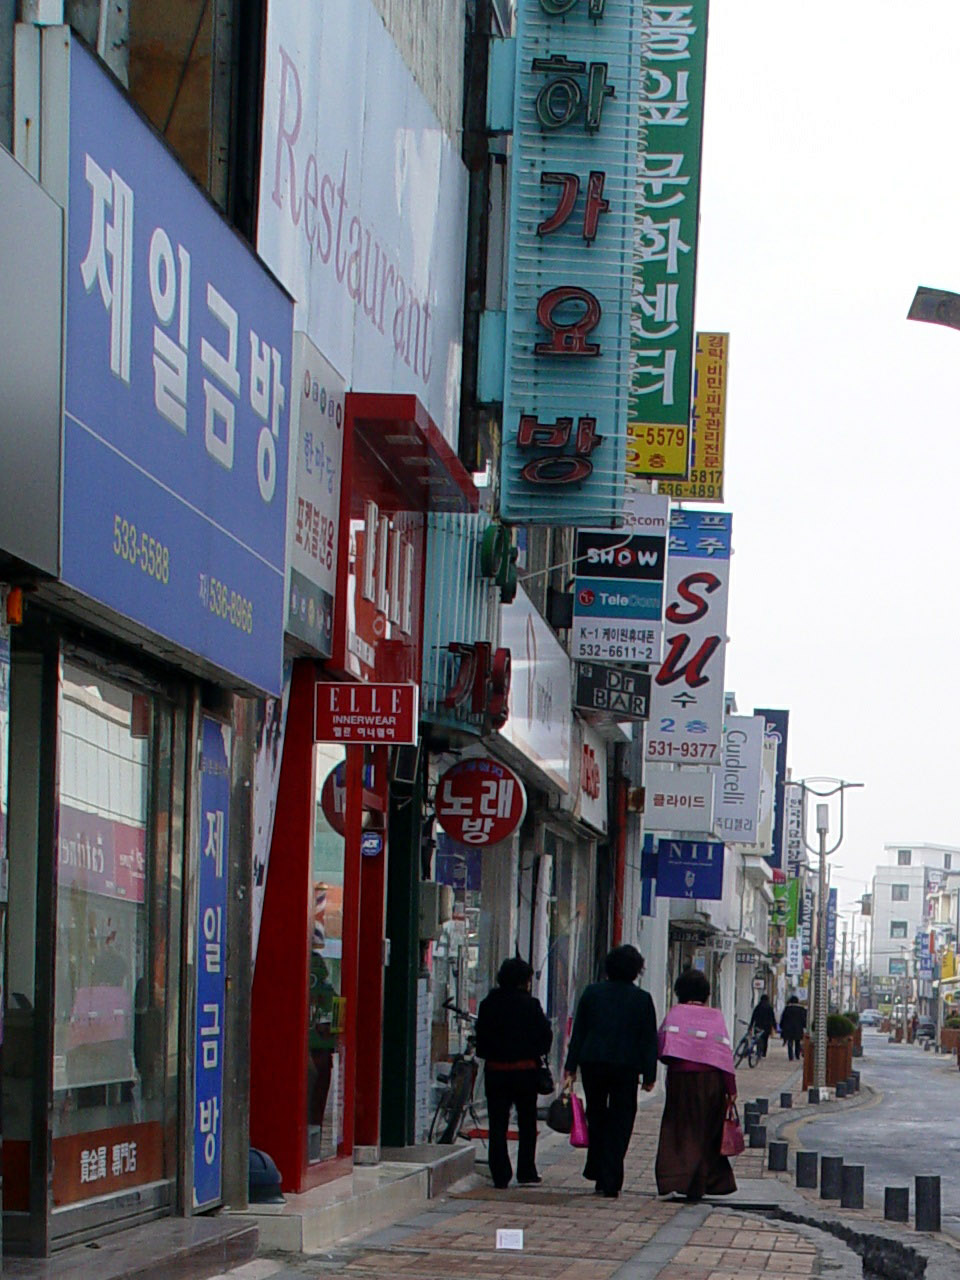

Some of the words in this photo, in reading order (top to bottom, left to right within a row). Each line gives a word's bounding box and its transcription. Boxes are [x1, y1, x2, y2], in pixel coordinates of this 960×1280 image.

[271, 46, 435, 384] Restaurant
[80, 153, 285, 501] 제일금방
[658, 484, 722, 498] 536-4891
[113, 513, 170, 585] 533-5588
[587, 549, 659, 567] SHOW
[330, 688, 402, 713] ELLE
[594, 690, 646, 714] BAR
[671, 692, 698, 708] 수
[332, 715, 397, 725] INNERWEAR
[648, 741, 718, 758] 531-9377
[723, 730, 748, 805] Guidicelli
[441, 779, 515, 819] 노래
[462, 817, 495, 844] 방
[670, 843, 713, 860] NII
[200, 810, 224, 1165] 제일금방
